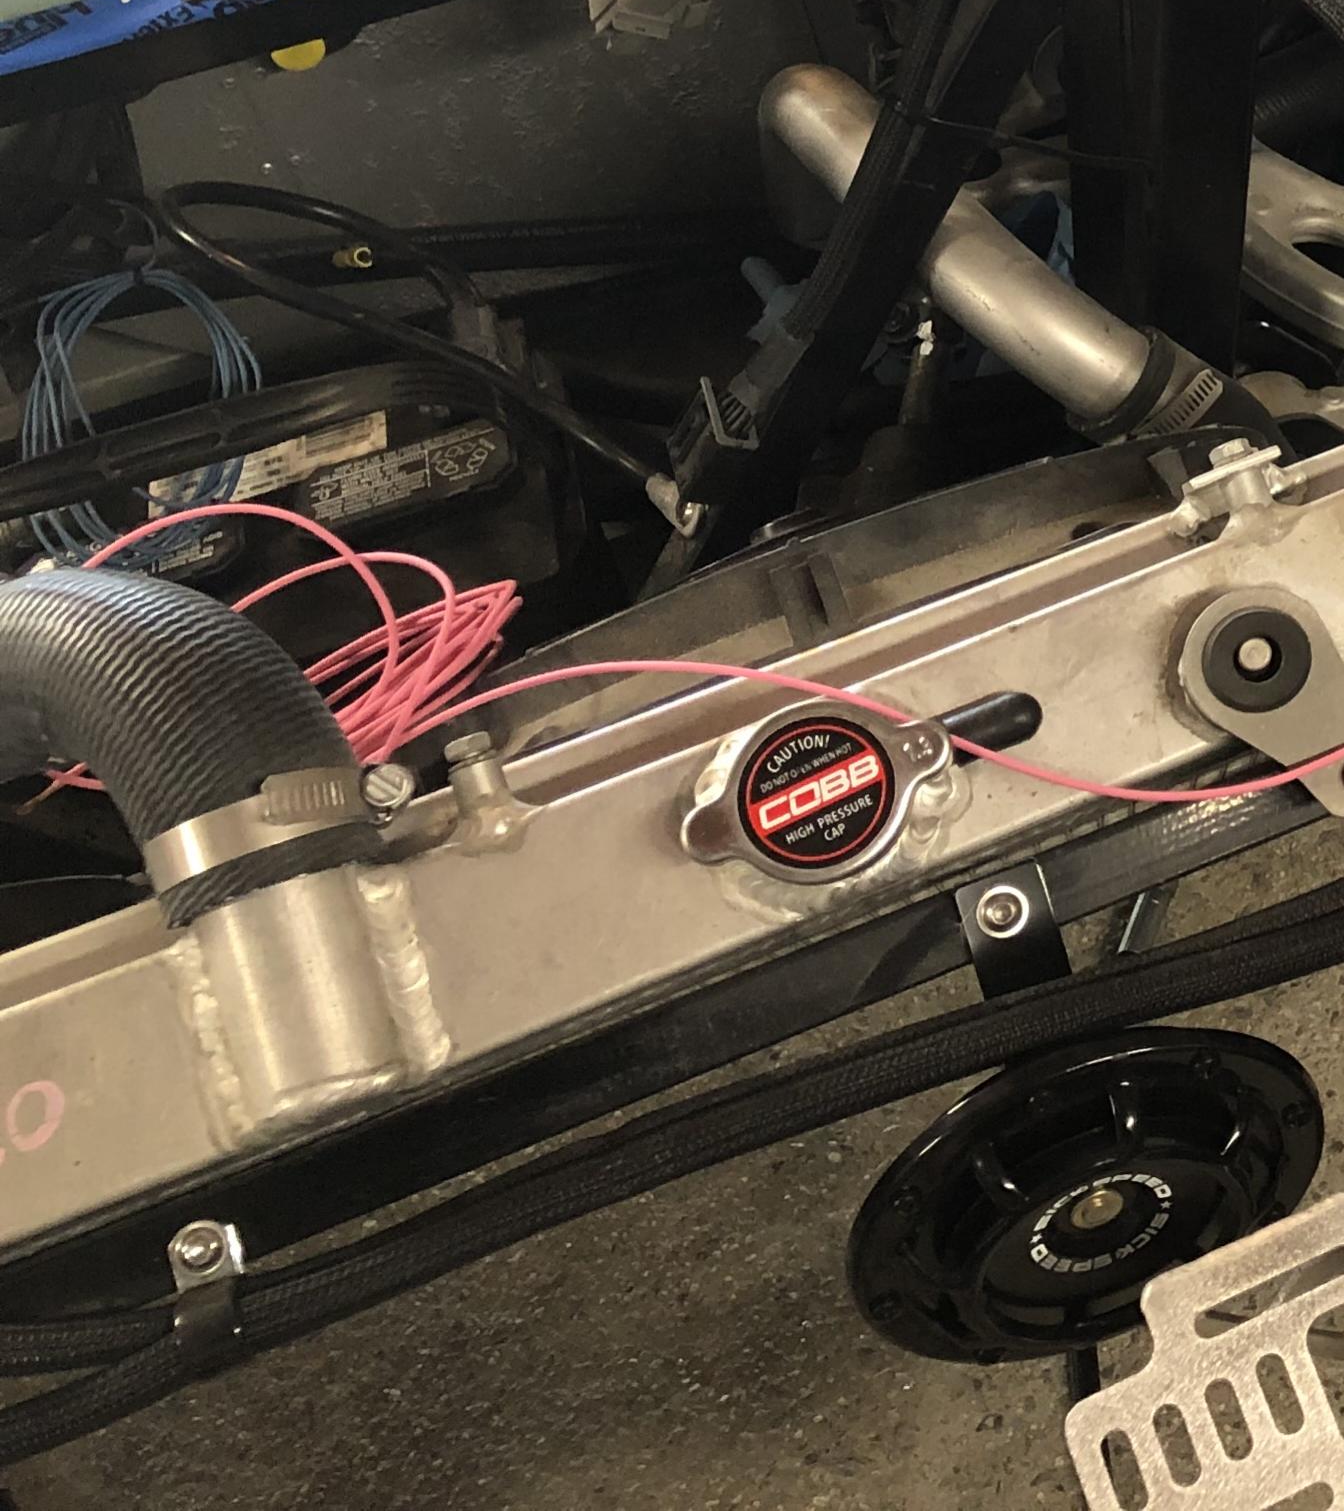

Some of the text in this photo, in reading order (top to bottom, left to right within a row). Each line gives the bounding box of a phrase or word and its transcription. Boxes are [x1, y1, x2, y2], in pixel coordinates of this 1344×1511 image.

[766, 733, 831, 774] CAUTION!
[758, 754, 880, 831] COBB
[785, 794, 875, 846] HIGH PRESSURE
[823, 823, 847, 842] CAP
